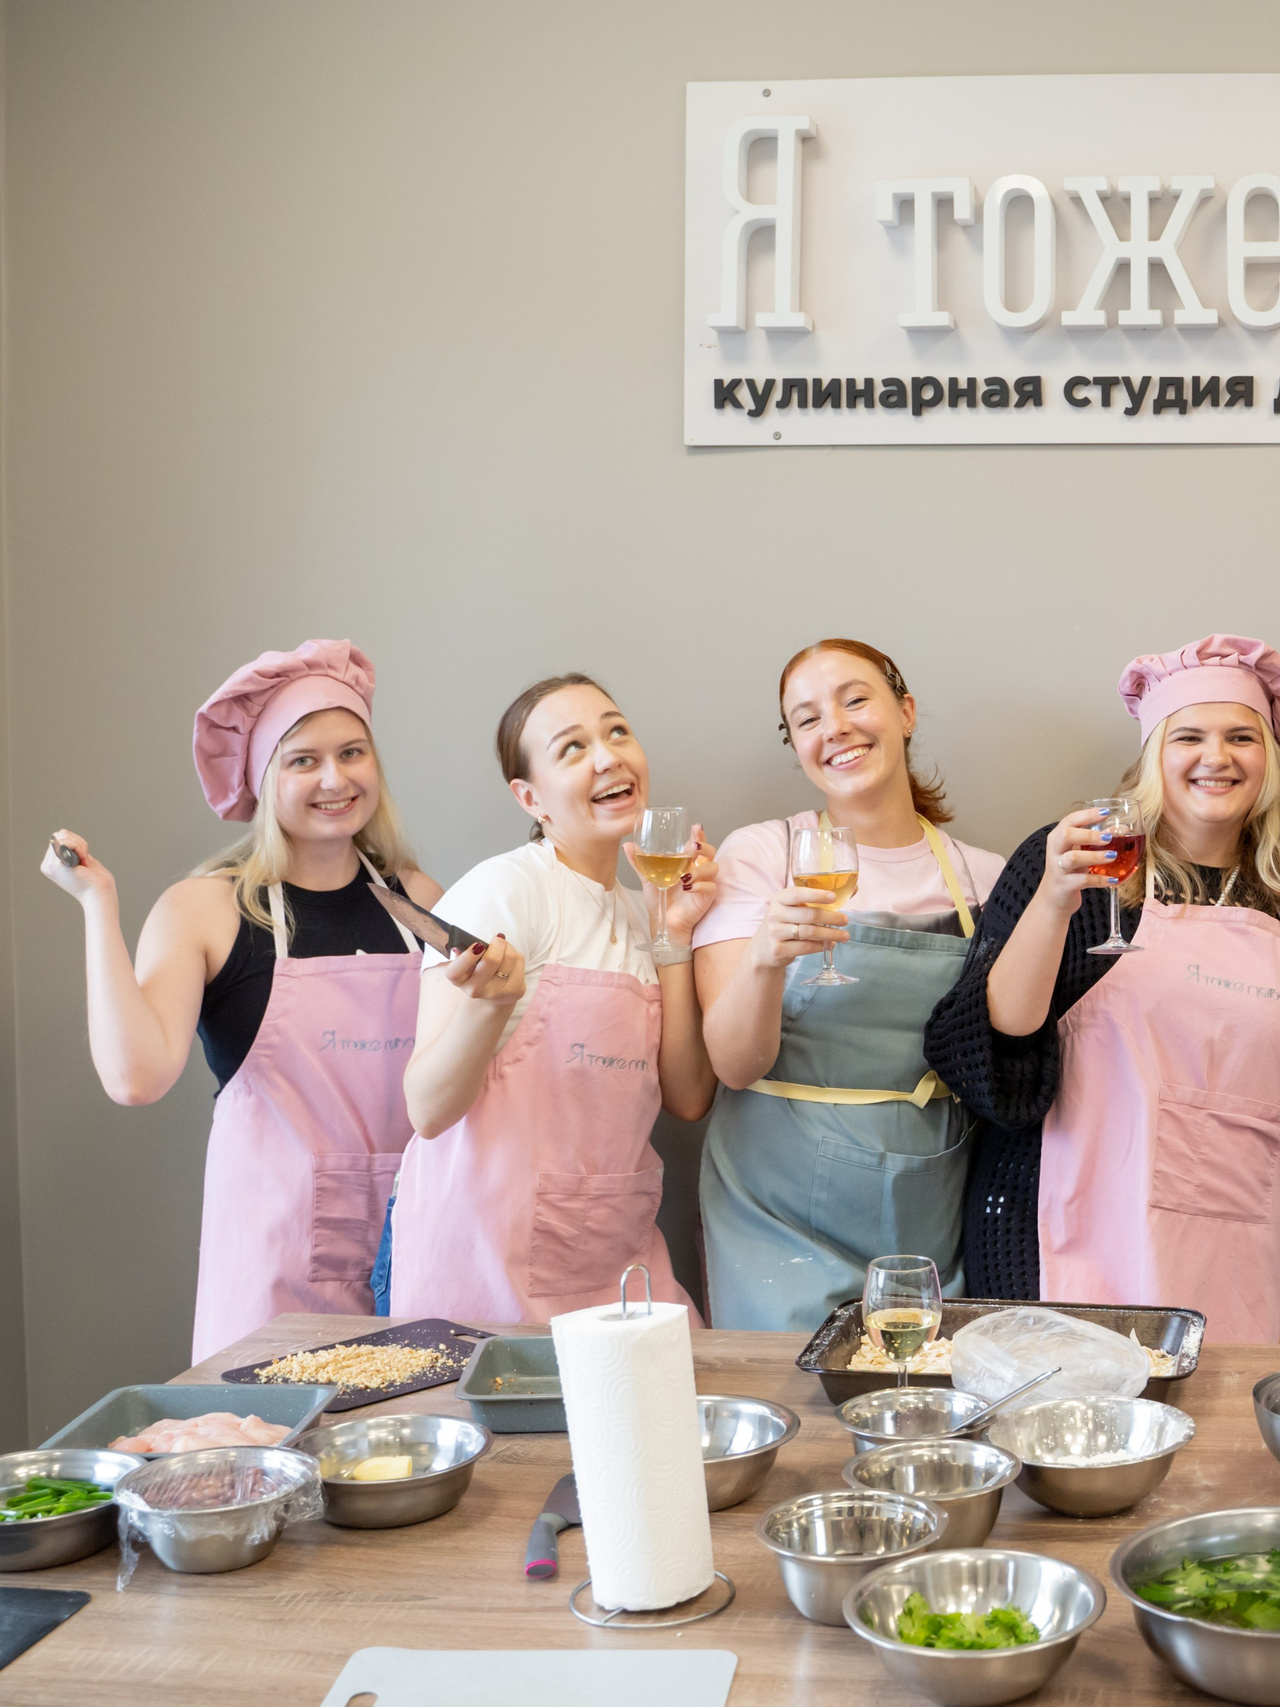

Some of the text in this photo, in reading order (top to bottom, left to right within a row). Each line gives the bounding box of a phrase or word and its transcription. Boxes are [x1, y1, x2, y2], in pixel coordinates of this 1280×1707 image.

[707, 114, 818, 332] Я
[713, 375, 1043, 417] кулинарная
[1063, 375, 1254, 416] студия
[1184, 964, 1200, 983] Я
[1204, 975, 1245, 993] тоже
[318, 1029, 336, 1052] Я
[340, 1039, 381, 1053] тоже
[565, 1043, 585, 1065] Я
[586, 1054, 626, 1070] тоже
